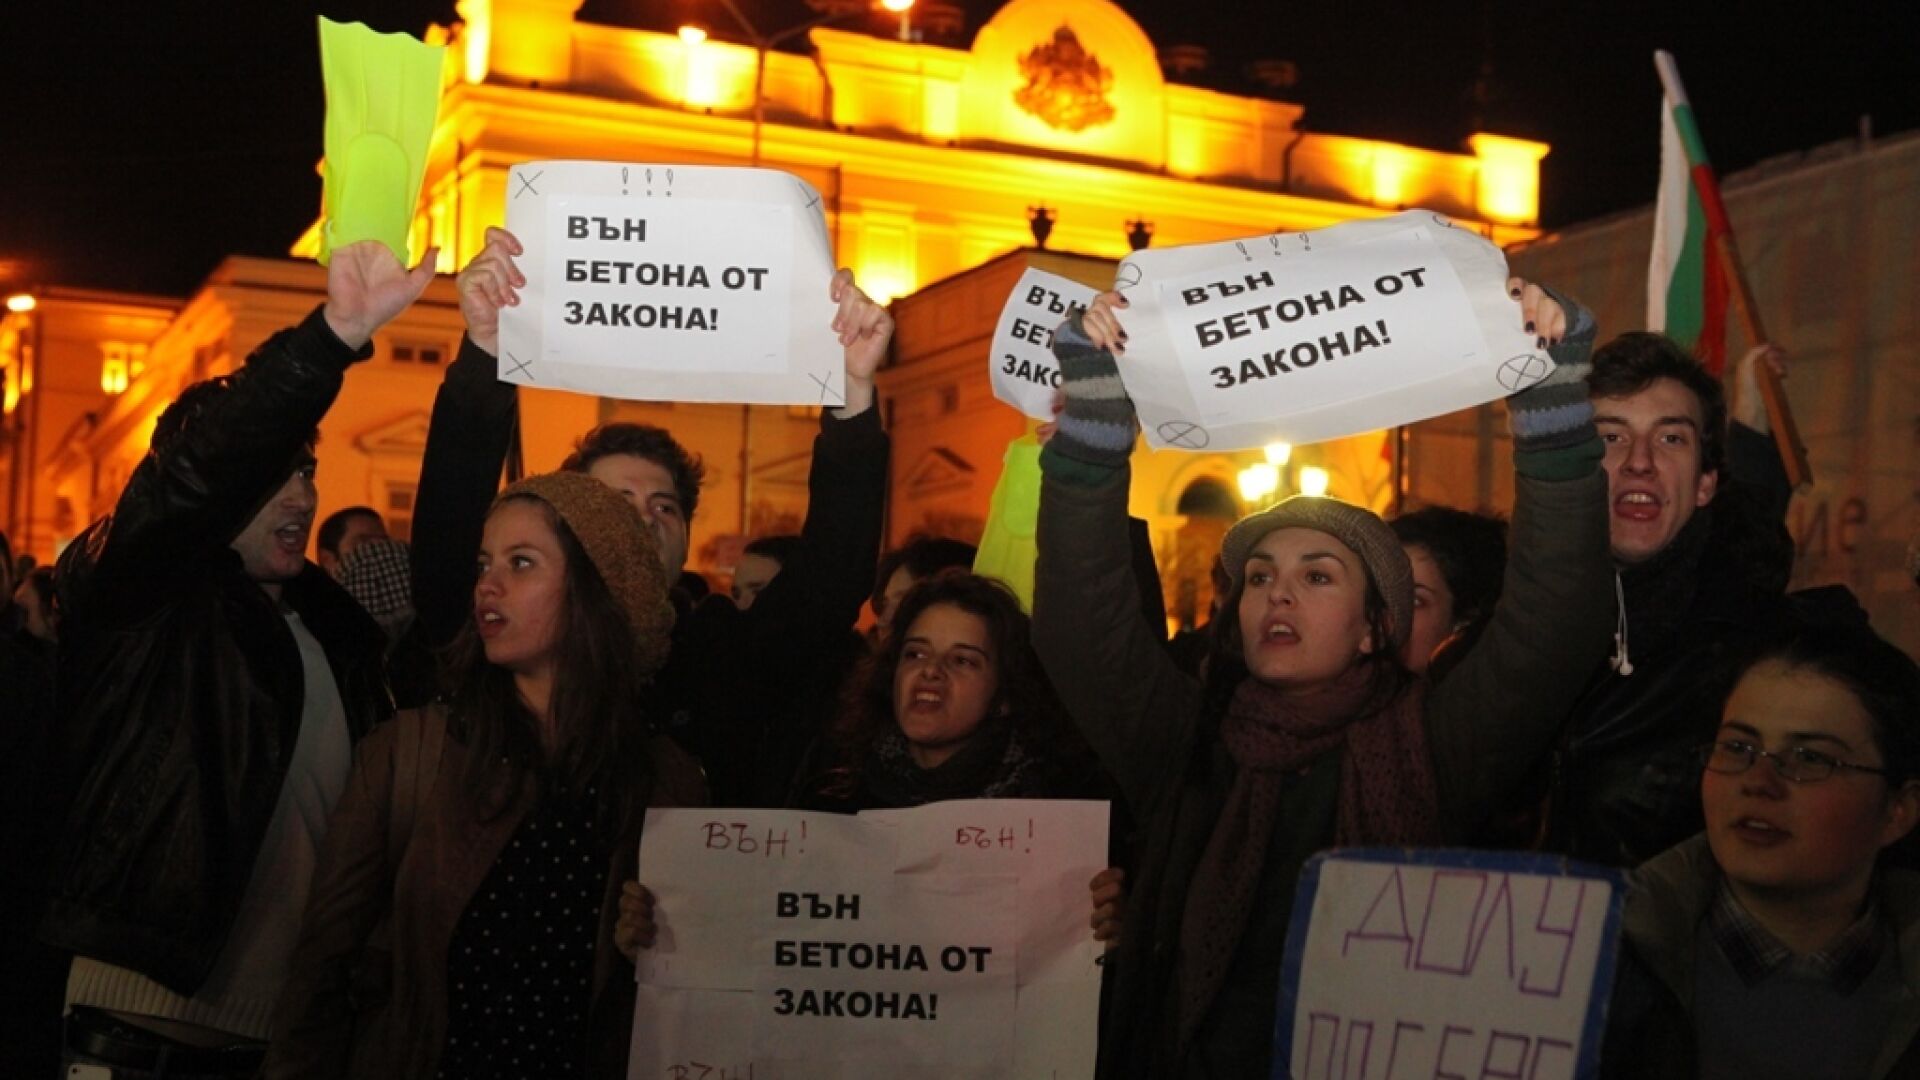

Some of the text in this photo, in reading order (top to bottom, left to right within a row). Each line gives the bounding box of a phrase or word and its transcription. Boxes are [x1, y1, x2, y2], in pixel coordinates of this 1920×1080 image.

[566, 215, 647, 243] ВЪН
[565, 259, 769, 291] БЕТОНА ОТ
[1181, 270, 1275, 307] ВЪН
[563, 301, 719, 331] ЗАКОНА!
[1195, 267, 1426, 349] БЕТОНА ОТ
[1210, 319, 1392, 389] ЗАКОНА!
[701, 819, 807, 858] ВЪН!
[775, 891, 860, 921] ВЪН
[1341, 866, 1587, 998] ДОЛУ
[774, 940, 993, 974] БЕТОНА ОТ
[773, 988, 938, 1021] ЗАКОНА!
